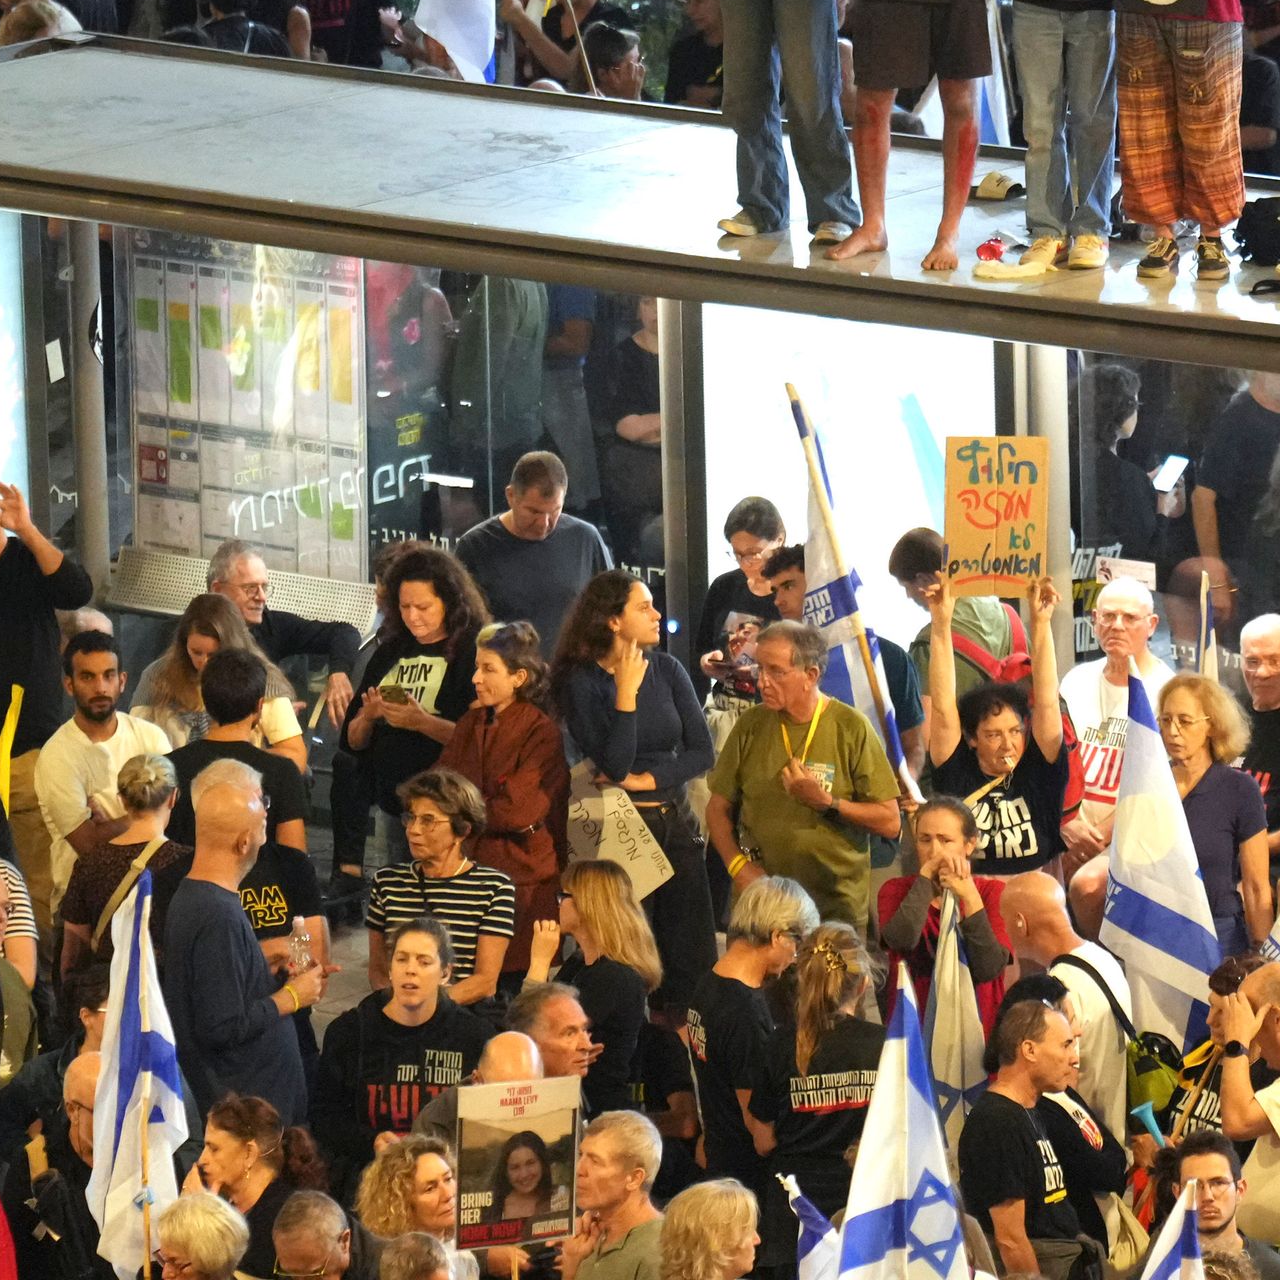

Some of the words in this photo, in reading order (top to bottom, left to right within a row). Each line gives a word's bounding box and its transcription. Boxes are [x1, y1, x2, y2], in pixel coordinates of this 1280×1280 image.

[957, 489, 1032, 530] מעזה
[1008, 524, 1036, 550] לא
[803, 588, 831, 613] חופ
[241, 888, 287, 910] AM
[252, 906, 288, 929] RS
[499, 1097, 522, 1107] NAAMA
[523, 1095, 538, 1106] LEVY
[461, 1191, 493, 1209] BRING
[461, 1208, 481, 1225] HER
